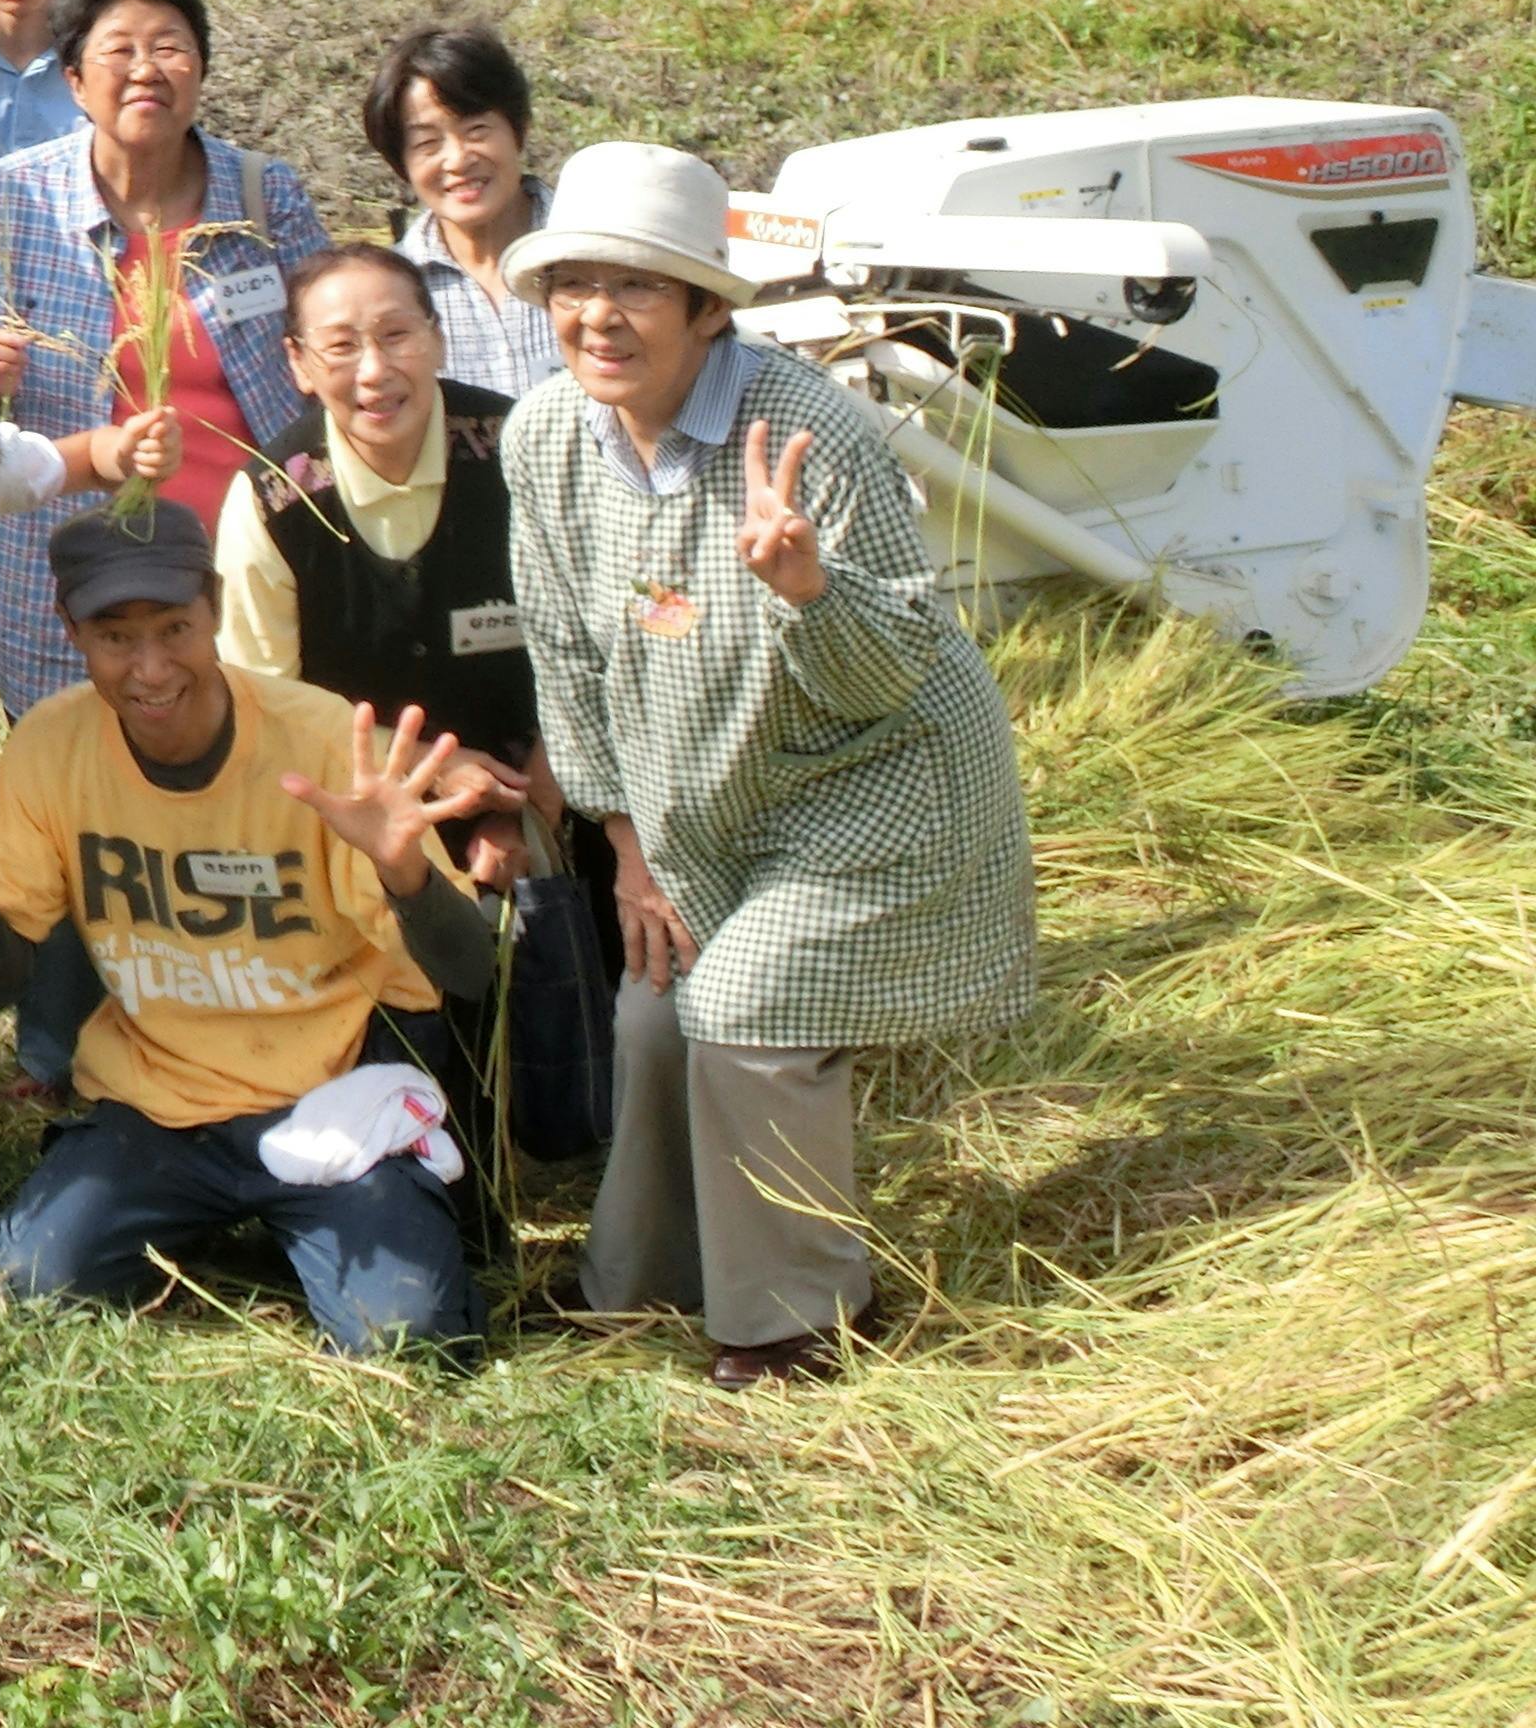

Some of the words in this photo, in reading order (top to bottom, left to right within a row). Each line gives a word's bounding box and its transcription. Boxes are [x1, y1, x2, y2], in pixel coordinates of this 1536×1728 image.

[1306, 148, 1443, 183] HS5000
[746, 212, 817, 248] Kubota
[78, 831, 319, 940] RISE
[91, 935, 118, 958] of
[96, 948, 322, 1015] quality
